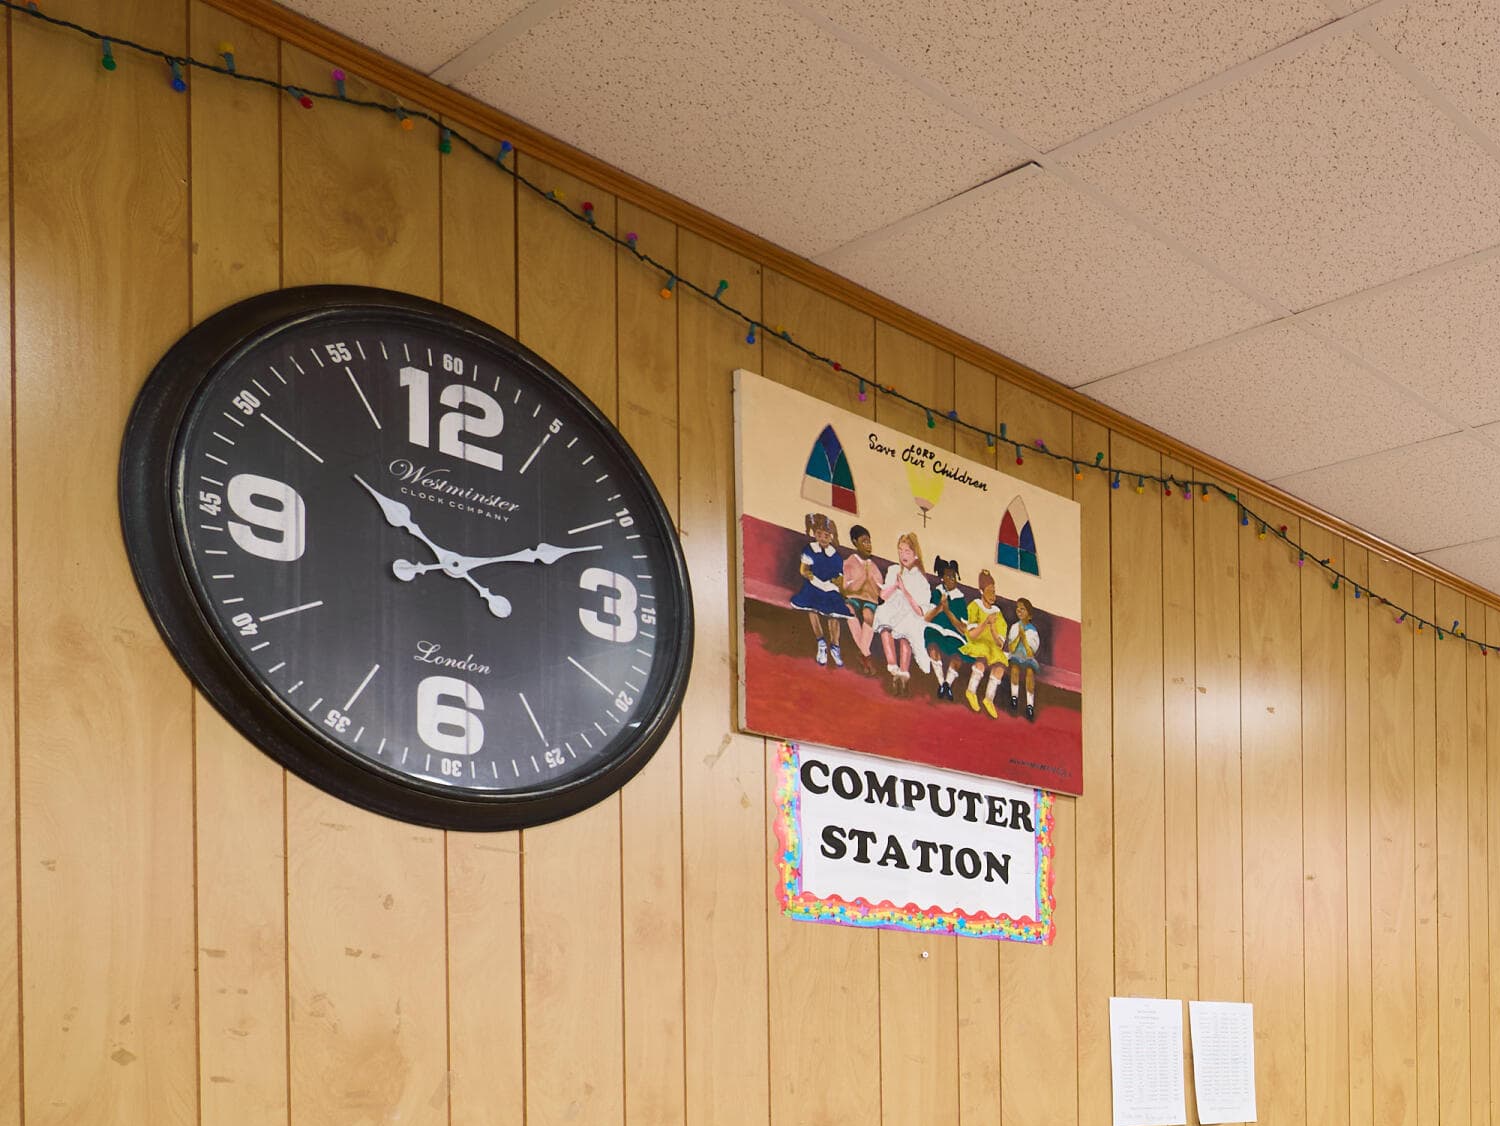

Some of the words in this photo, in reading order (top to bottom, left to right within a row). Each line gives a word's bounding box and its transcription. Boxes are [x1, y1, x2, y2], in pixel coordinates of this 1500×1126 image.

[325, 341, 352, 364] 55
[442, 353, 464, 375] 60
[232, 390, 261, 416] 50
[400, 366, 504, 472] 12
[547, 419, 563, 434] 5
[868, 433, 896, 458] Save
[901, 448, 925, 468] Our
[932, 460, 988, 492] Children
[389, 458, 520, 512] Westminster
[199, 490, 221, 516] 45
[400, 486, 444, 505] CLOCK
[448, 500, 510, 523] COMPANY
[227, 472, 306, 562] 9
[614, 507, 634, 529] 10
[578, 567, 637, 644] 3
[640, 606, 656, 625] 15
[232, 611, 259, 637] 40
[413, 639, 491, 675] London
[416, 675, 484, 755] 6
[614, 693, 633, 713] 20
[324, 708, 352, 733] 35
[441, 758, 462, 777] 30
[544, 748, 565, 769] 25
[799, 758, 1036, 834] COMPUTER
[820, 824, 1012, 885] STATION
